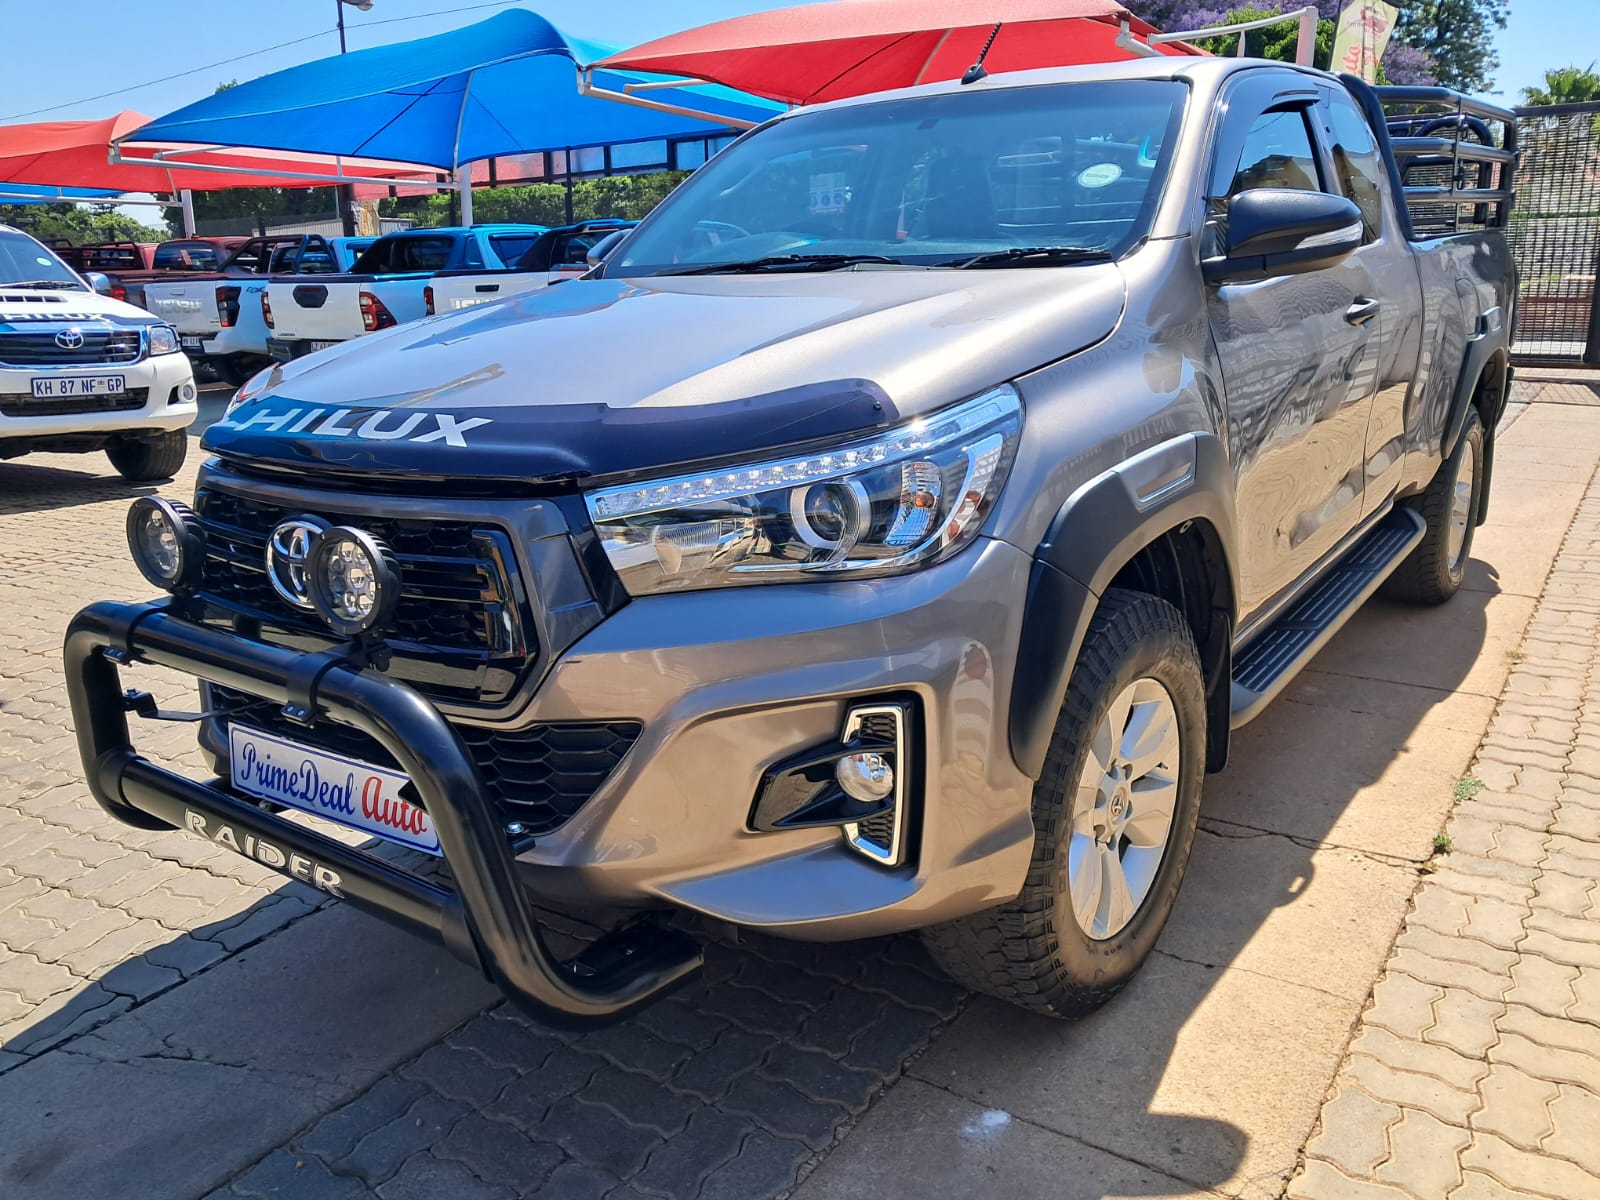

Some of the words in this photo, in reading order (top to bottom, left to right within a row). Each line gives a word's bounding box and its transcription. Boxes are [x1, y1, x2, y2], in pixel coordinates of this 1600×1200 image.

[36, 381, 52, 395] KH
[60, 380, 74, 394] 87
[81, 379, 96, 393] NF
[107, 378, 122, 392] GP
[234, 408, 493, 447] HILUX
[241, 742, 357, 815] PrimeDeal
[362, 776, 427, 835] Auto
[185, 808, 345, 898] RAIDER
